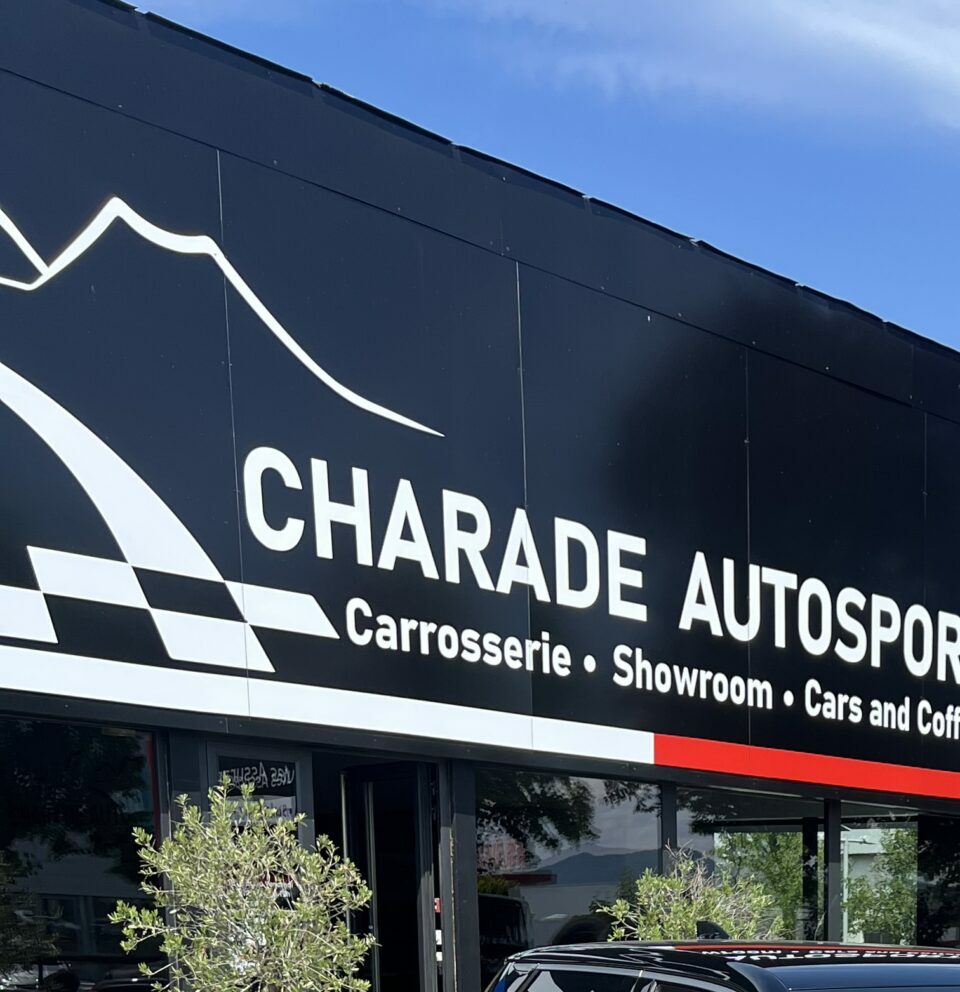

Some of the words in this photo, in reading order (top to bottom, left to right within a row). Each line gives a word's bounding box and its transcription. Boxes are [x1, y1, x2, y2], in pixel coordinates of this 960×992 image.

[243, 446, 648, 622] CHARADE
[346, 597, 572, 677] Carrosserie
[612, 644, 773, 710] Showroom
[804, 678, 862, 723] Cars
[869, 697, 911, 732] and
